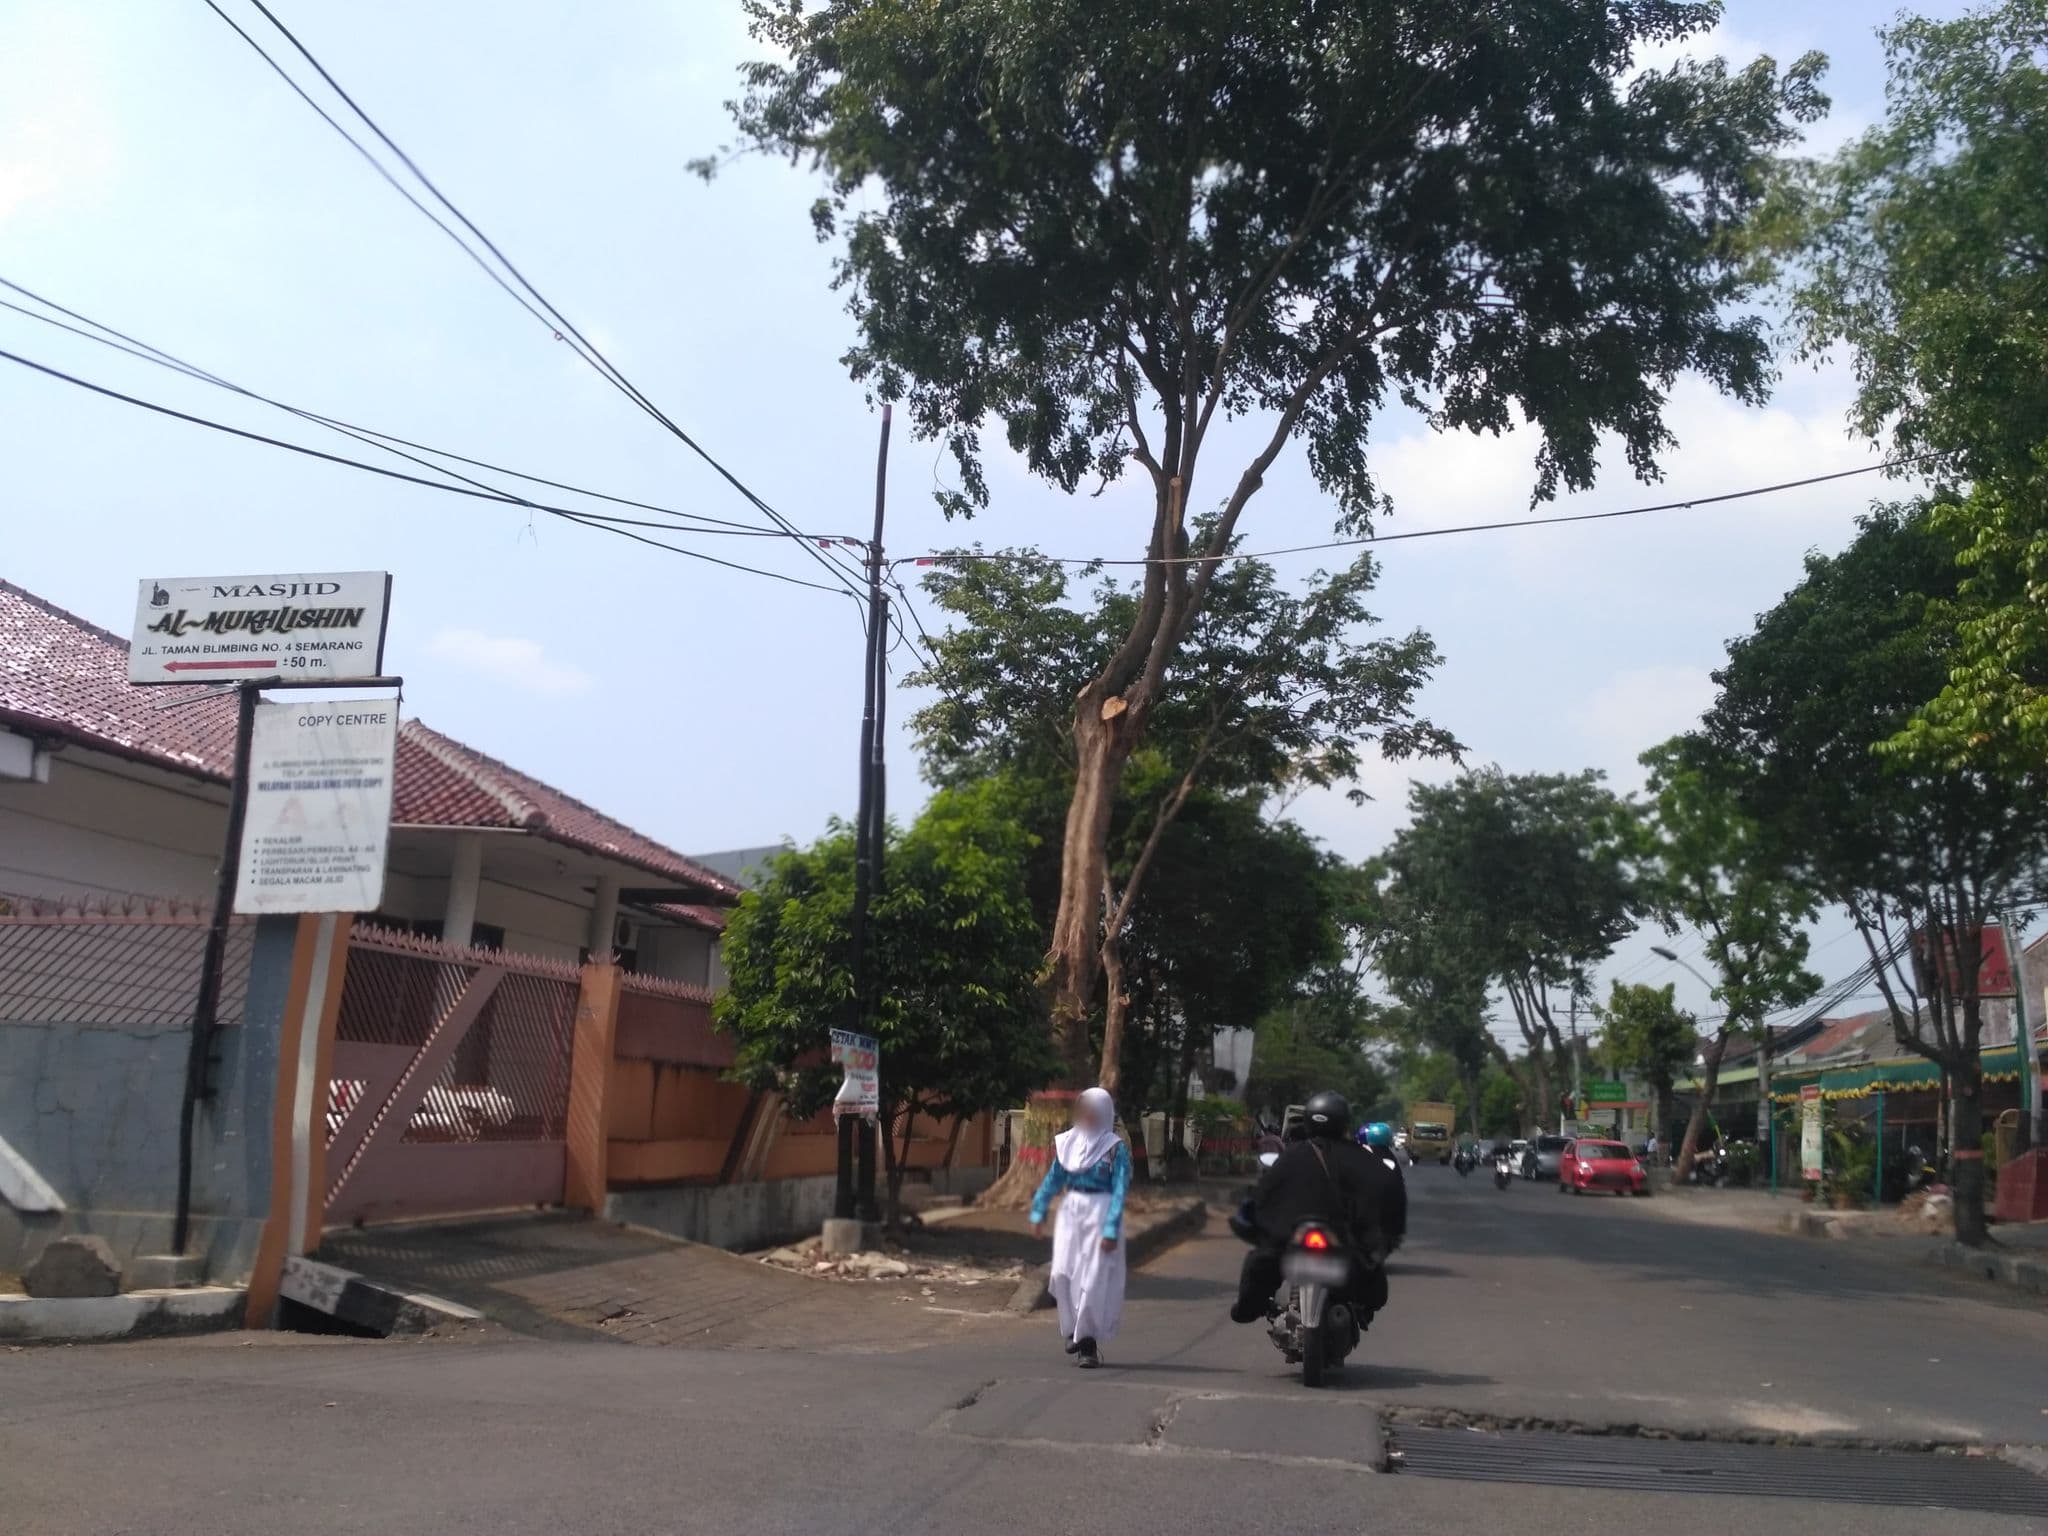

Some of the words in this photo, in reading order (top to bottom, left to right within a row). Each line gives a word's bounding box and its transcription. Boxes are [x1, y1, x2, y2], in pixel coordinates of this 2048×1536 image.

[212, 582, 341, 599] MASJID
[142, 645, 157, 656] JL.
[162, 644, 200, 655] TAMAN
[203, 643, 258, 654] BLIMBING
[262, 643, 282, 653] NO.
[285, 643, 292, 651] 4
[295, 641, 363, 652] SEMARANG
[298, 714, 333, 727] COPY
[336, 713, 387, 726] CENTRE
[259, 877, 291, 886] SEGALA
[293, 876, 323, 884] MACAM
